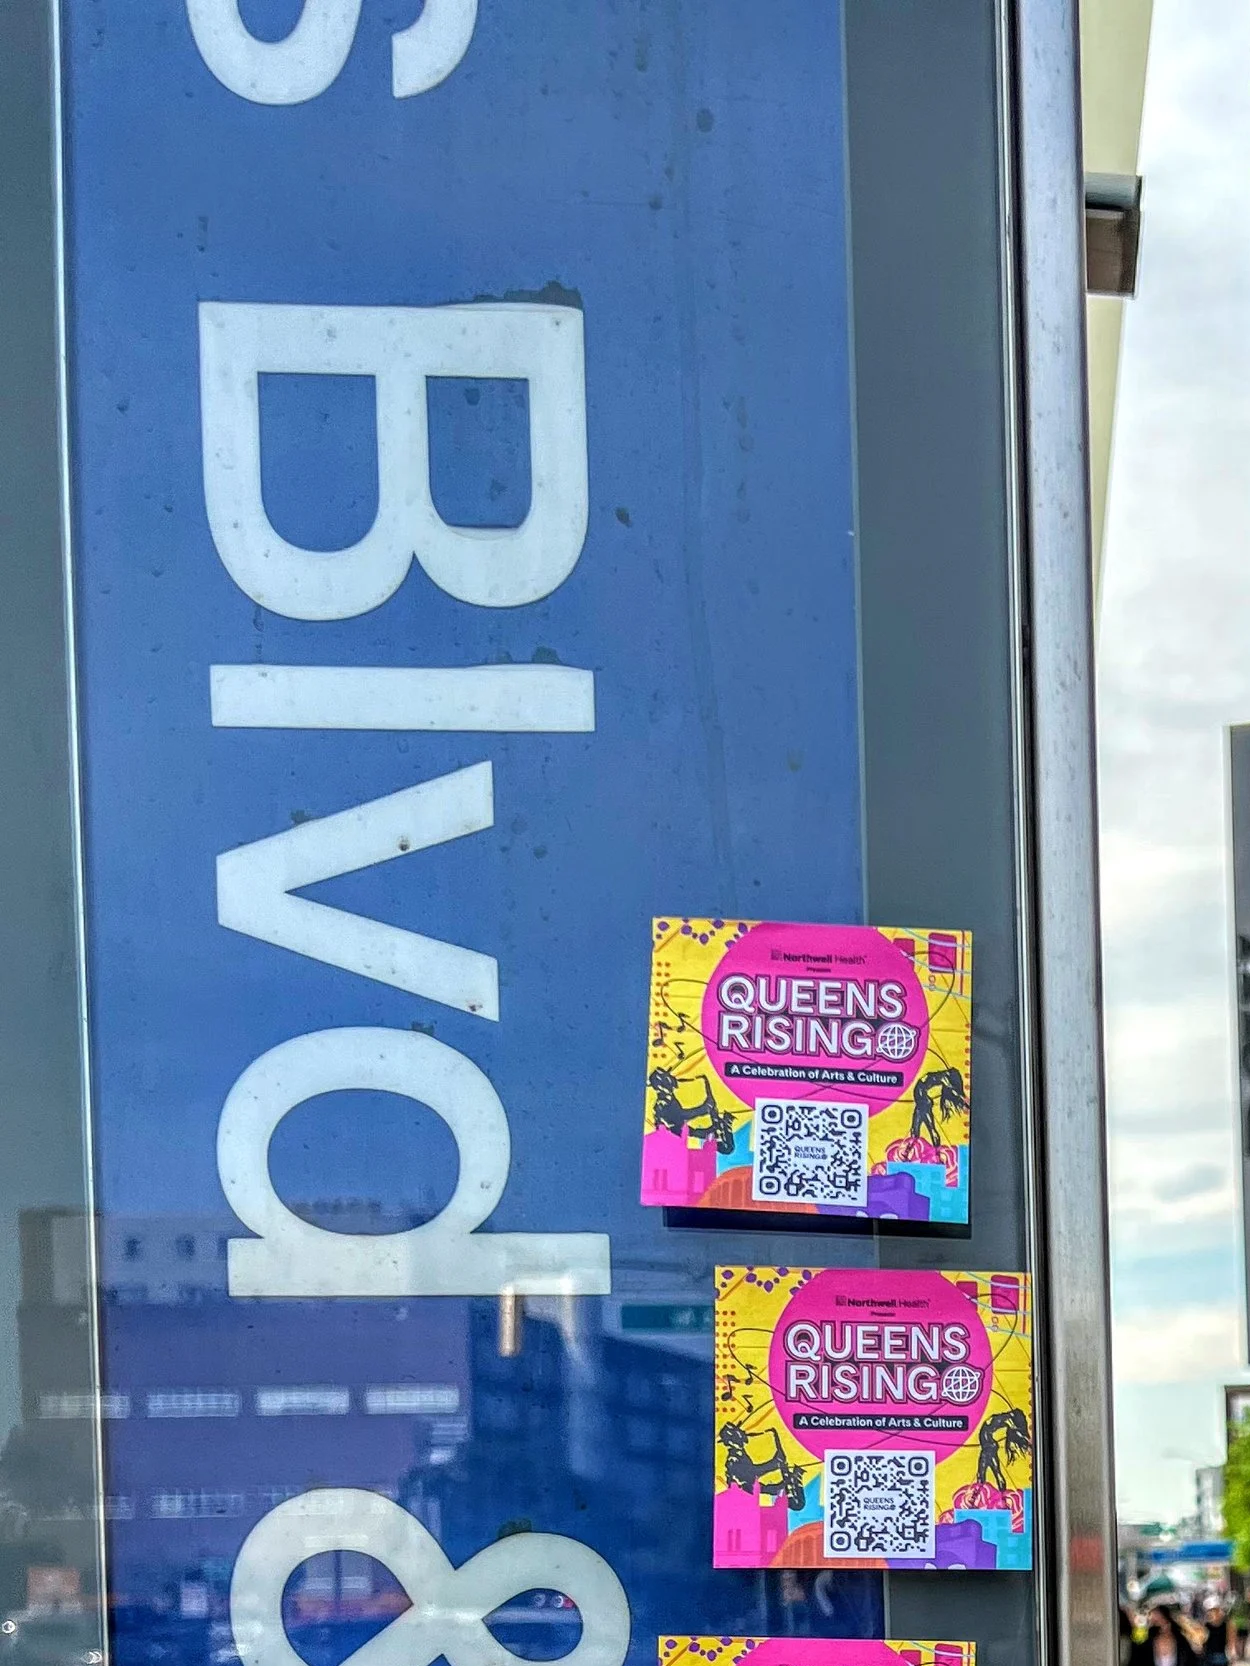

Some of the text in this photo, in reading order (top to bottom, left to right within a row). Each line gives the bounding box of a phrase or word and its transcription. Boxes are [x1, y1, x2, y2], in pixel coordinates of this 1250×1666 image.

[199, 302, 612, 1296] Blvd
[783, 953, 866, 965] Northwell Health
[719, 973, 905, 1019] QUEENS
[720, 1013, 873, 1057] RISING
[731, 1065, 898, 1084] A Celebration of Arts & Culture
[847, 1298, 929, 1308] Northwell Health
[785, 1322, 969, 1361] QUEENS
[787, 1363, 939, 1401] RISING
[799, 1417, 963, 1428] A Celebration of Arts & Culture
